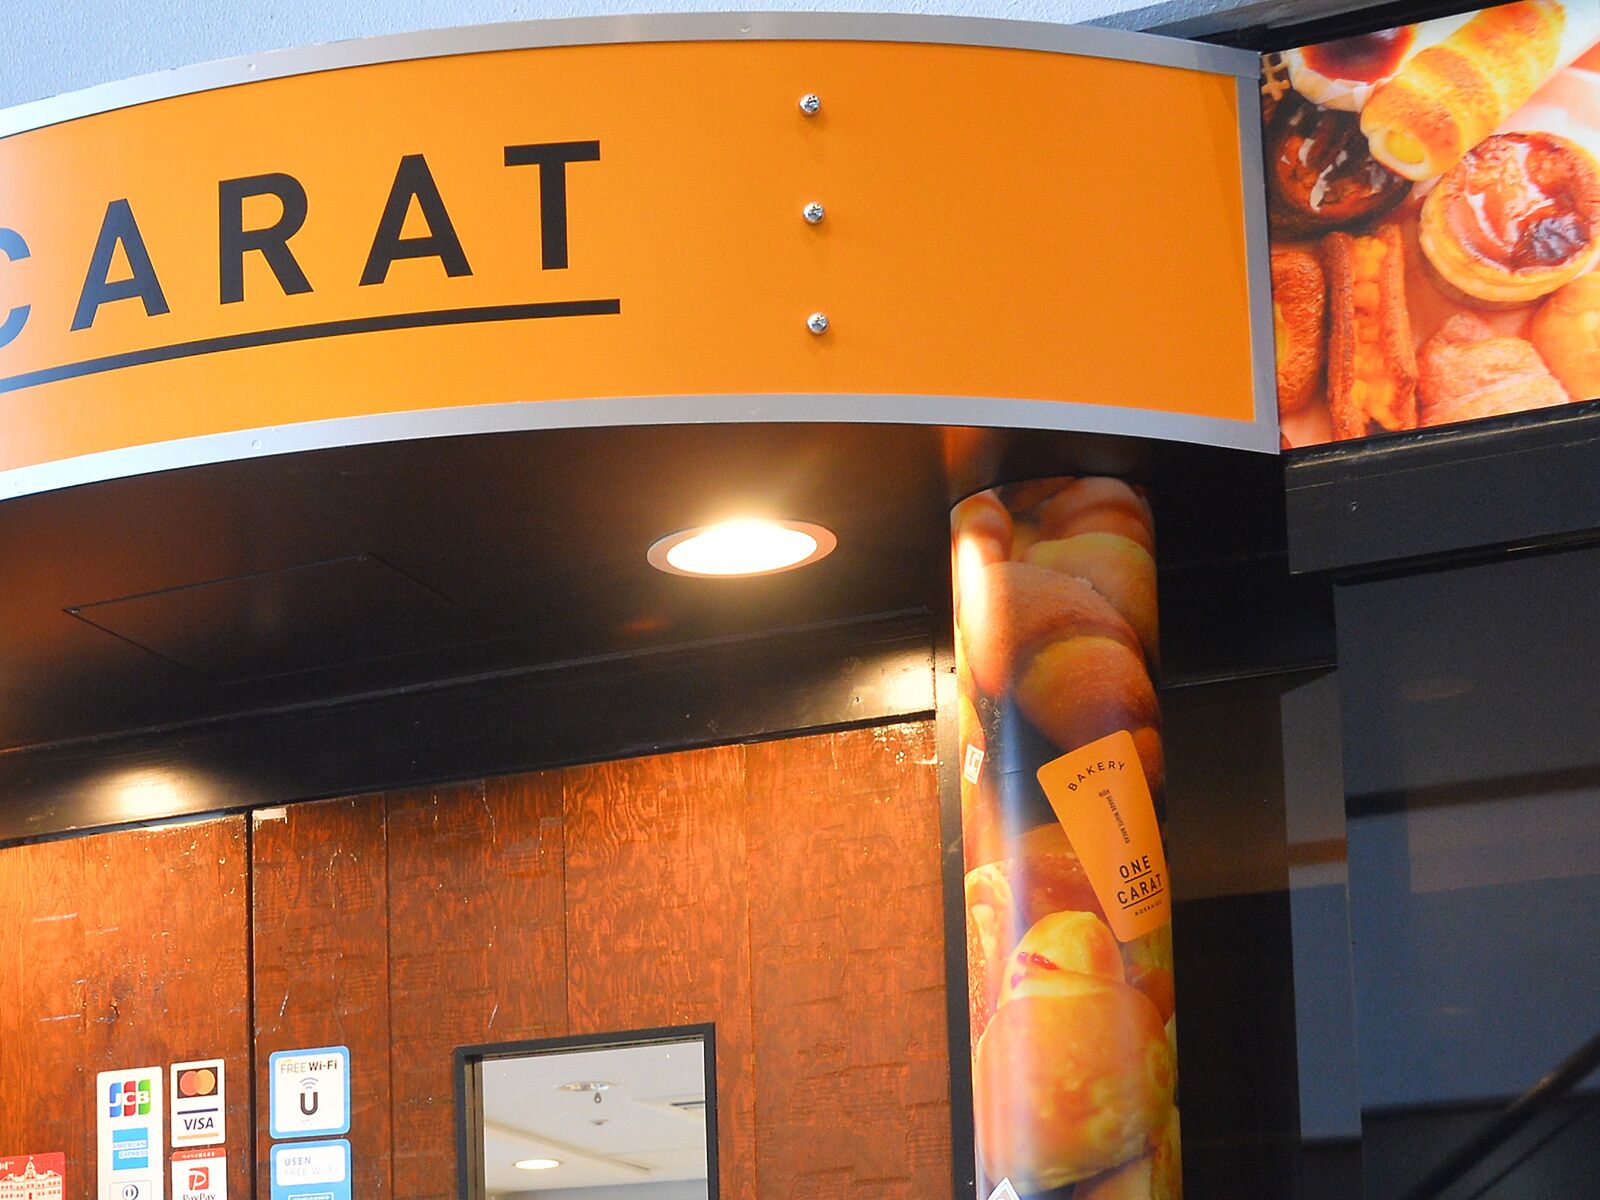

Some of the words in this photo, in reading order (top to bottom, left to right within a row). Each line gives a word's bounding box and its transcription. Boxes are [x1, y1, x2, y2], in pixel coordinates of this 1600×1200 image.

[1067, 760, 1126, 792] BAKERY
[1119, 855, 1151, 879] ONE
[1117, 873, 1162, 905] CARAT
[281, 1062, 307, 1074] FREE
[308, 1060, 338, 1071] Wi-Fi
[184, 1117, 214, 1131] VISA
[284, 1157, 312, 1166] USEN
